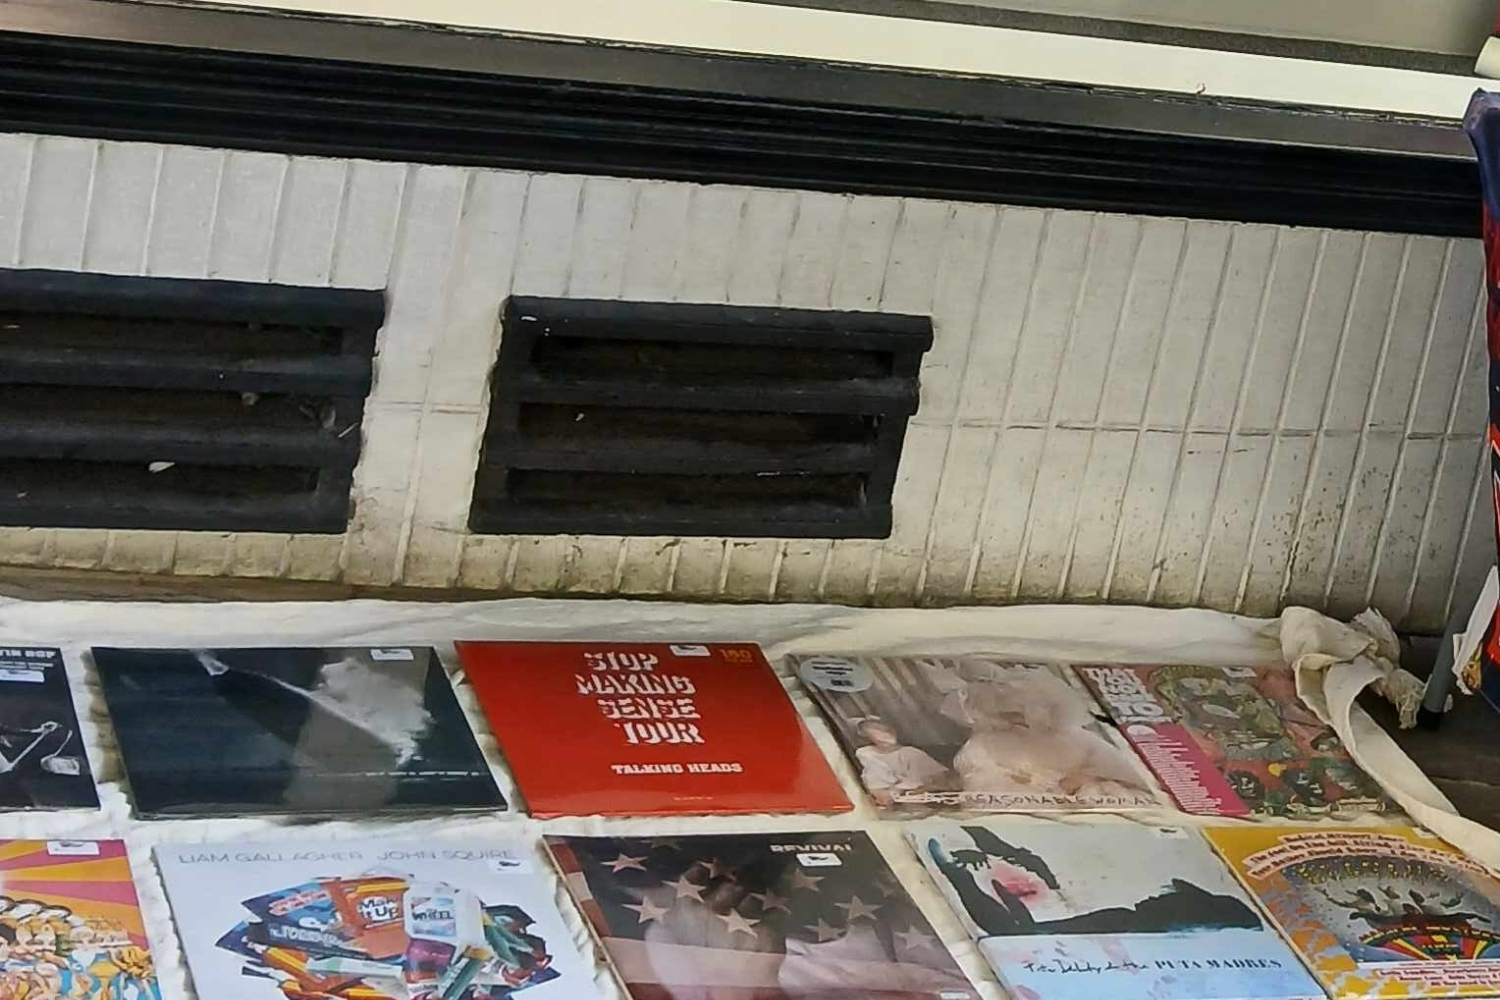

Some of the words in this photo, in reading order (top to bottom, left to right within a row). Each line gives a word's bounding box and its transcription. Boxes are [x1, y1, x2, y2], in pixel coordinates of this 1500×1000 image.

[583, 650, 660, 672] STOP
[574, 673, 697, 695] MAKING
[597, 698, 701, 720] SENSE
[613, 721, 705, 744] TOUR
[610, 763, 684, 774] TALKING
[686, 762, 743, 773] HEADS
[179, 854, 230, 864] LIAM
[235, 851, 363, 863] GALLAGHER
[377, 850, 436, 863] JOHN
[439, 850, 513, 861] SQUIRE
[1155, 959, 1202, 970] PUTA
[1204, 958, 1283, 969] MADRES
